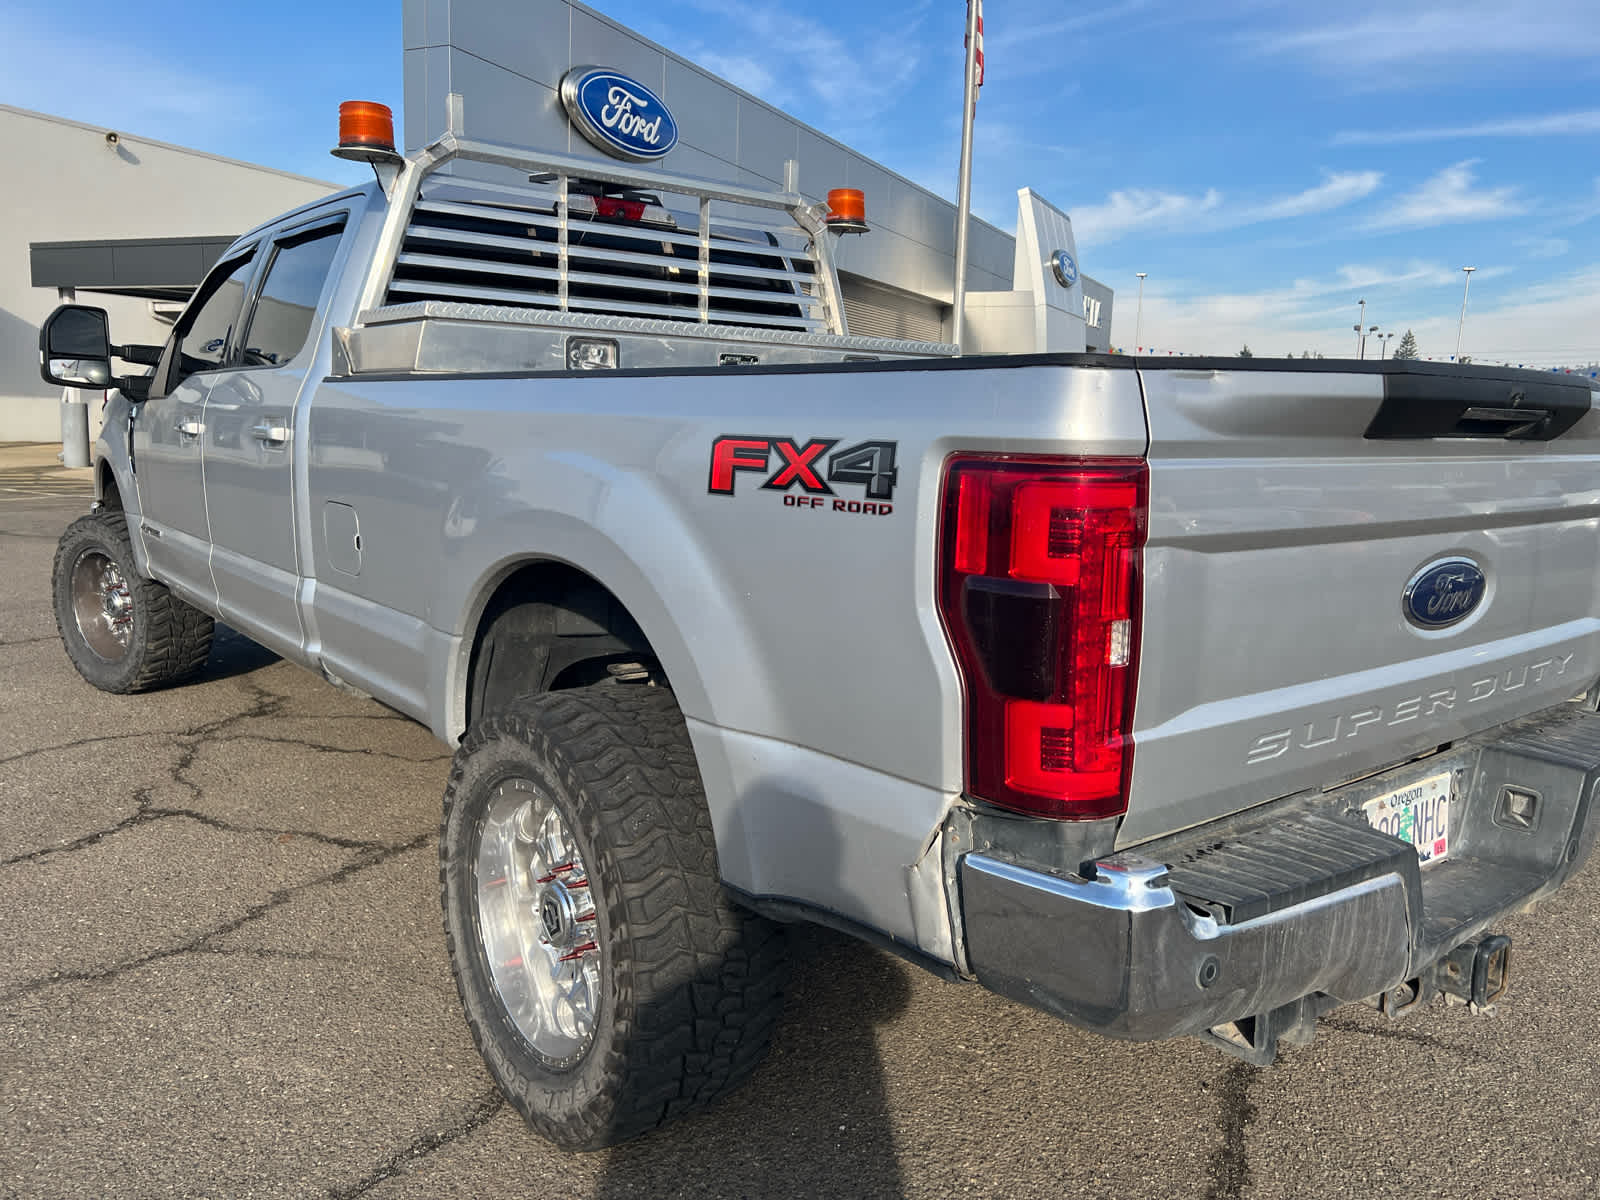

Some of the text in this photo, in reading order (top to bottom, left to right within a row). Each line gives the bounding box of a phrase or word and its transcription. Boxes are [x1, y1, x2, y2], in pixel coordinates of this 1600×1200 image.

[601, 86, 662, 145] Ford
[708, 435, 898, 500] FX4
[783, 495, 893, 516] OFF ROAD
[1427, 573, 1475, 615] Ford
[1247, 652, 1574, 764] SUPER DUTY
[1390, 787, 1422, 808] Oregon
[1412, 794, 1447, 846] NHC
